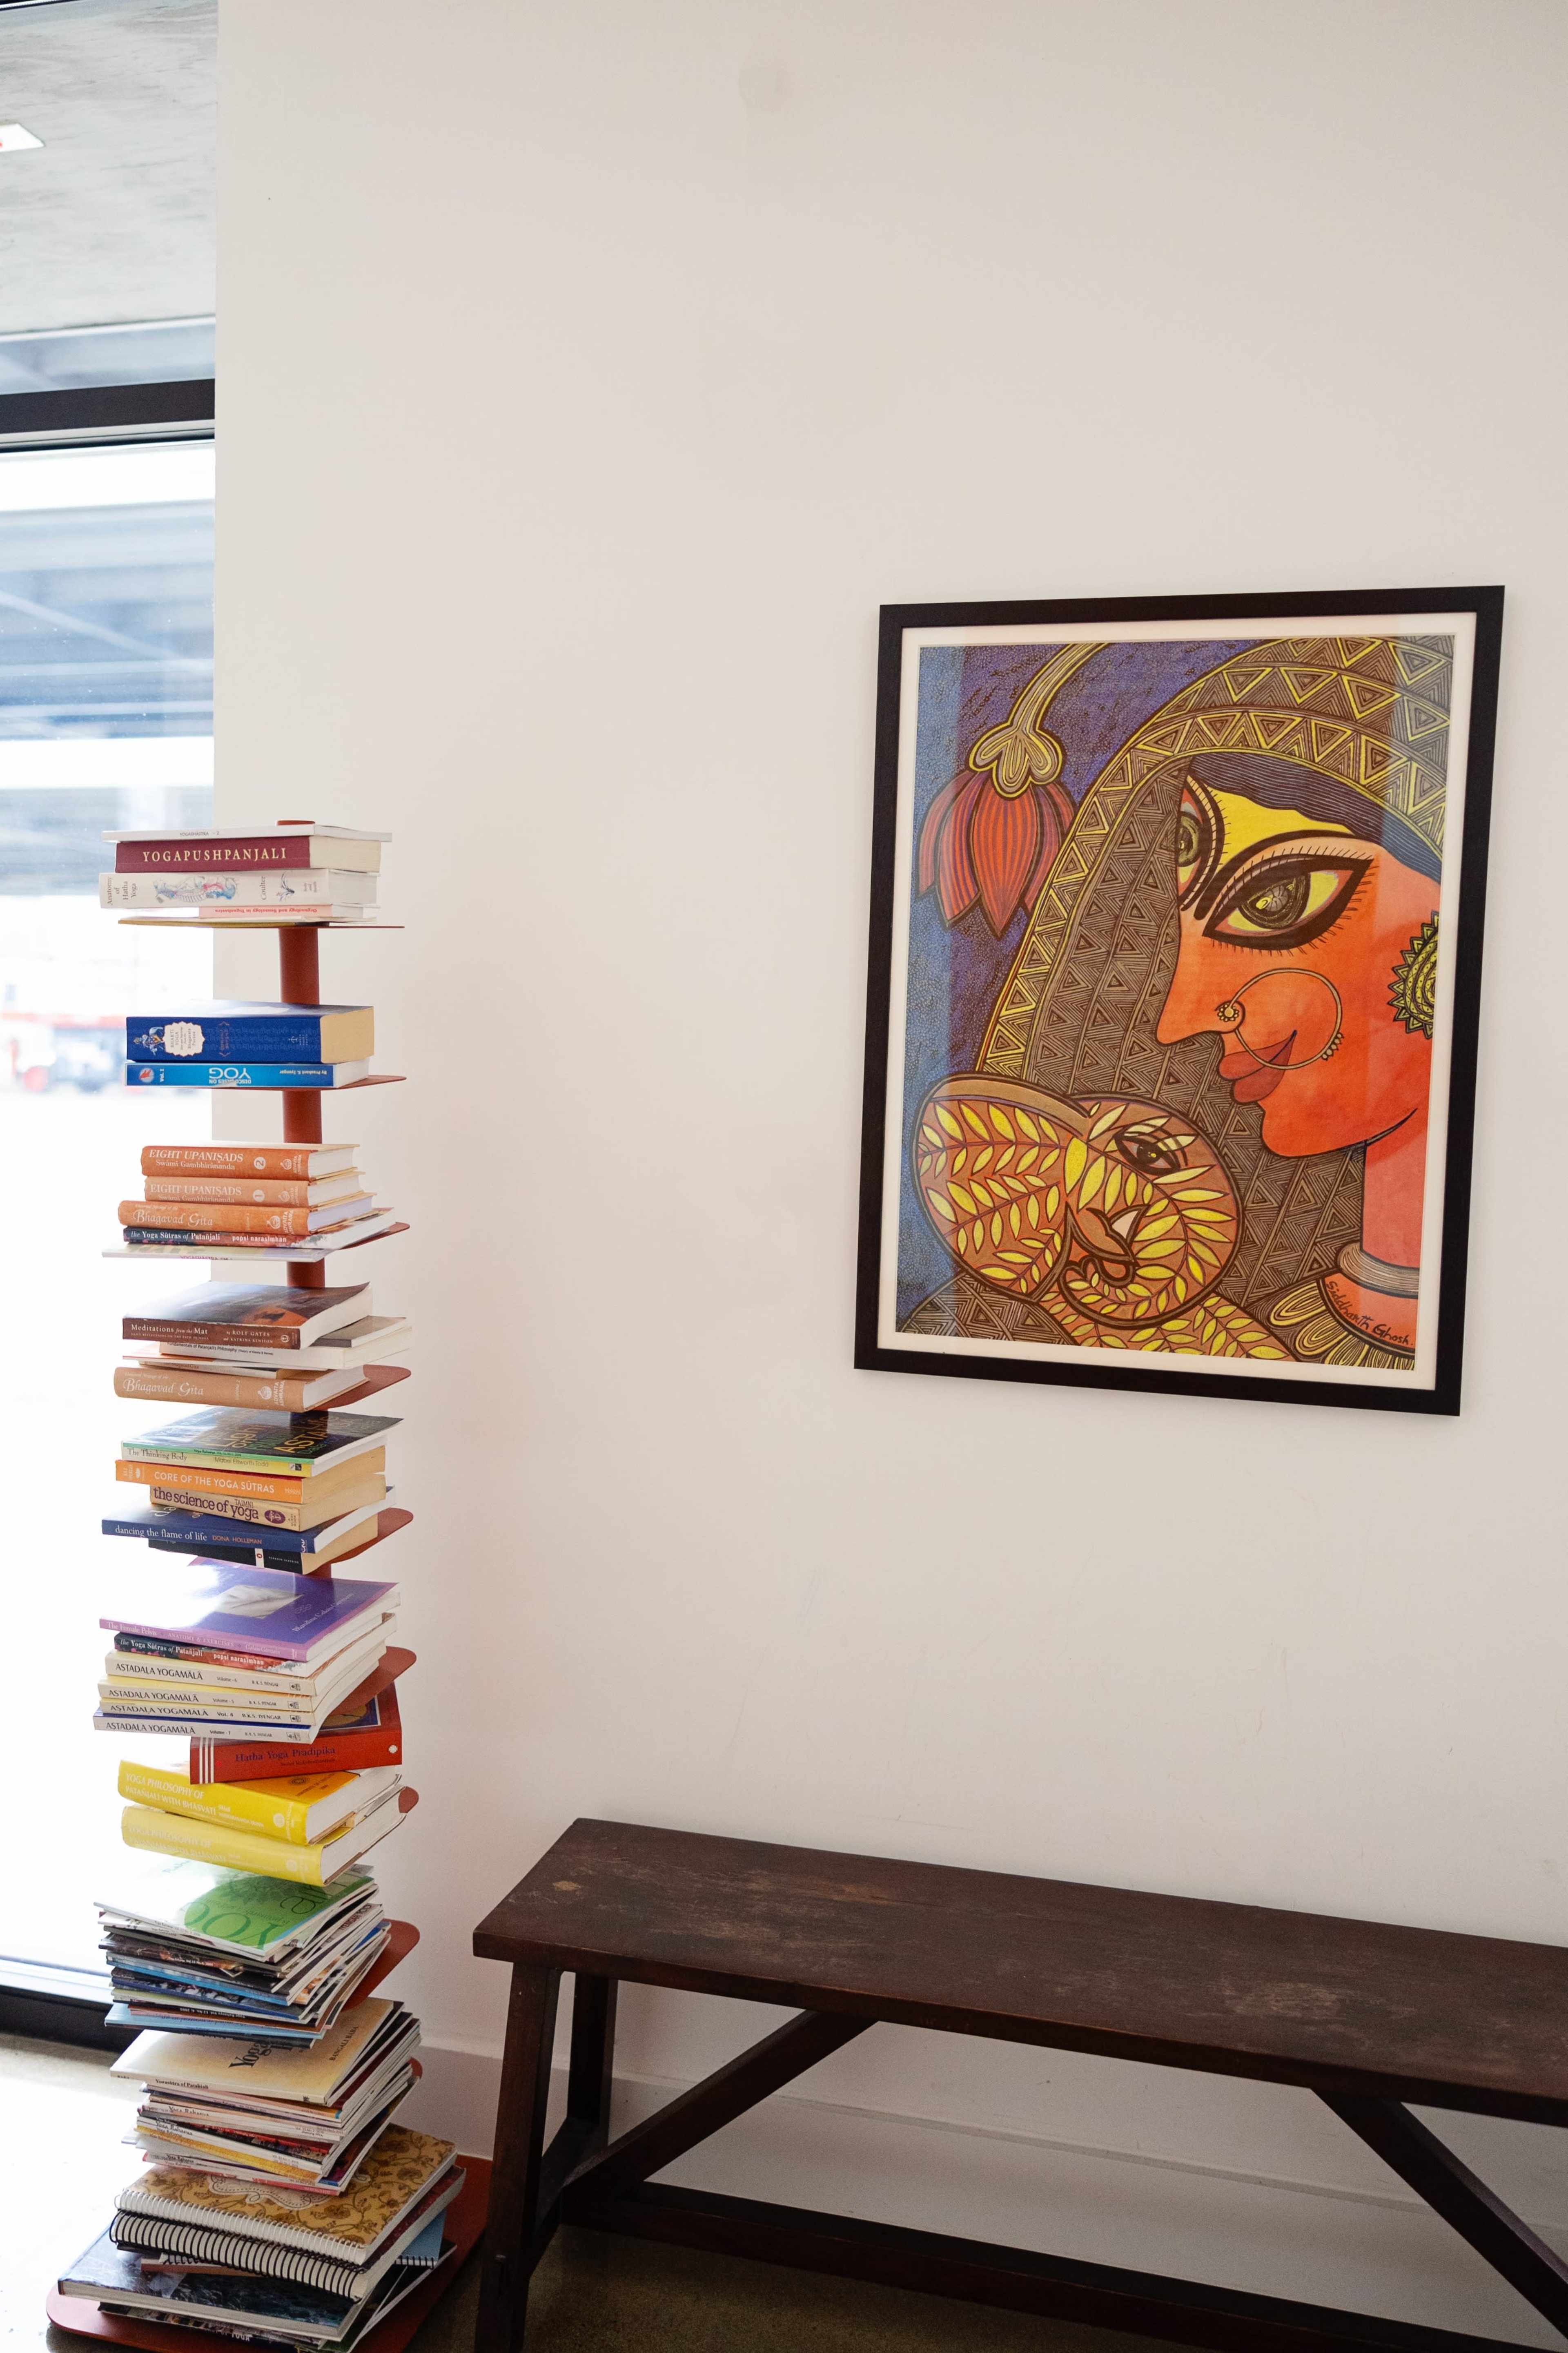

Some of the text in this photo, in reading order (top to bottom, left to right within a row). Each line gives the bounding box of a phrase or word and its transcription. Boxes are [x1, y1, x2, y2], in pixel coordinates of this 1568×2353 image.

[143, 848, 286, 862] YOGAPUSHPANJALI
[209, 1067, 251, 1079] YOG
[149, 1149, 182, 1159] EIGHT
[150, 1184, 182, 1194] EIGHT
[133, 1209, 213, 1226] Bhagavad Gita
[131, 1324, 174, 1332] Meditations
[123, 1378, 203, 1396] Bhagavad Gita
[127, 1448, 187, 1462] The Thinking Body
[154, 1471, 178, 1481] CORE
[180, 1475, 193, 1483] OF
[194, 1476, 211, 1486] THE
[214, 1479, 238, 1490] YOGA
[154, 1487, 259, 1521] the science of yoga
[234, 1499, 254, 1509] TAIMNI
[115, 1525, 144, 1538] dancing
[147, 1528, 159, 1537] the
[161, 1529, 183, 1539] flame
[195, 1532, 207, 1541] life
[232, 1536, 262, 1544] HOLLEMAN
[120, 1624, 140, 1633] Female
[141, 1628, 157, 1636] Pelvis
[131, 1640, 145, 1648] Yoga
[168, 1632, 194, 1642] ANATOMY
[203, 1638, 234, 1647] EXERCISES
[230, 1656, 264, 1665] narasimhan
[235, 1746, 336, 1762] Hatha Yoga Pradipika
[126, 1773, 205, 1799] YOGA PHILOSOPHY OF
[162, 1795, 181, 1805] WITH
[329, 2026, 359, 2061] BANGALI BABA
